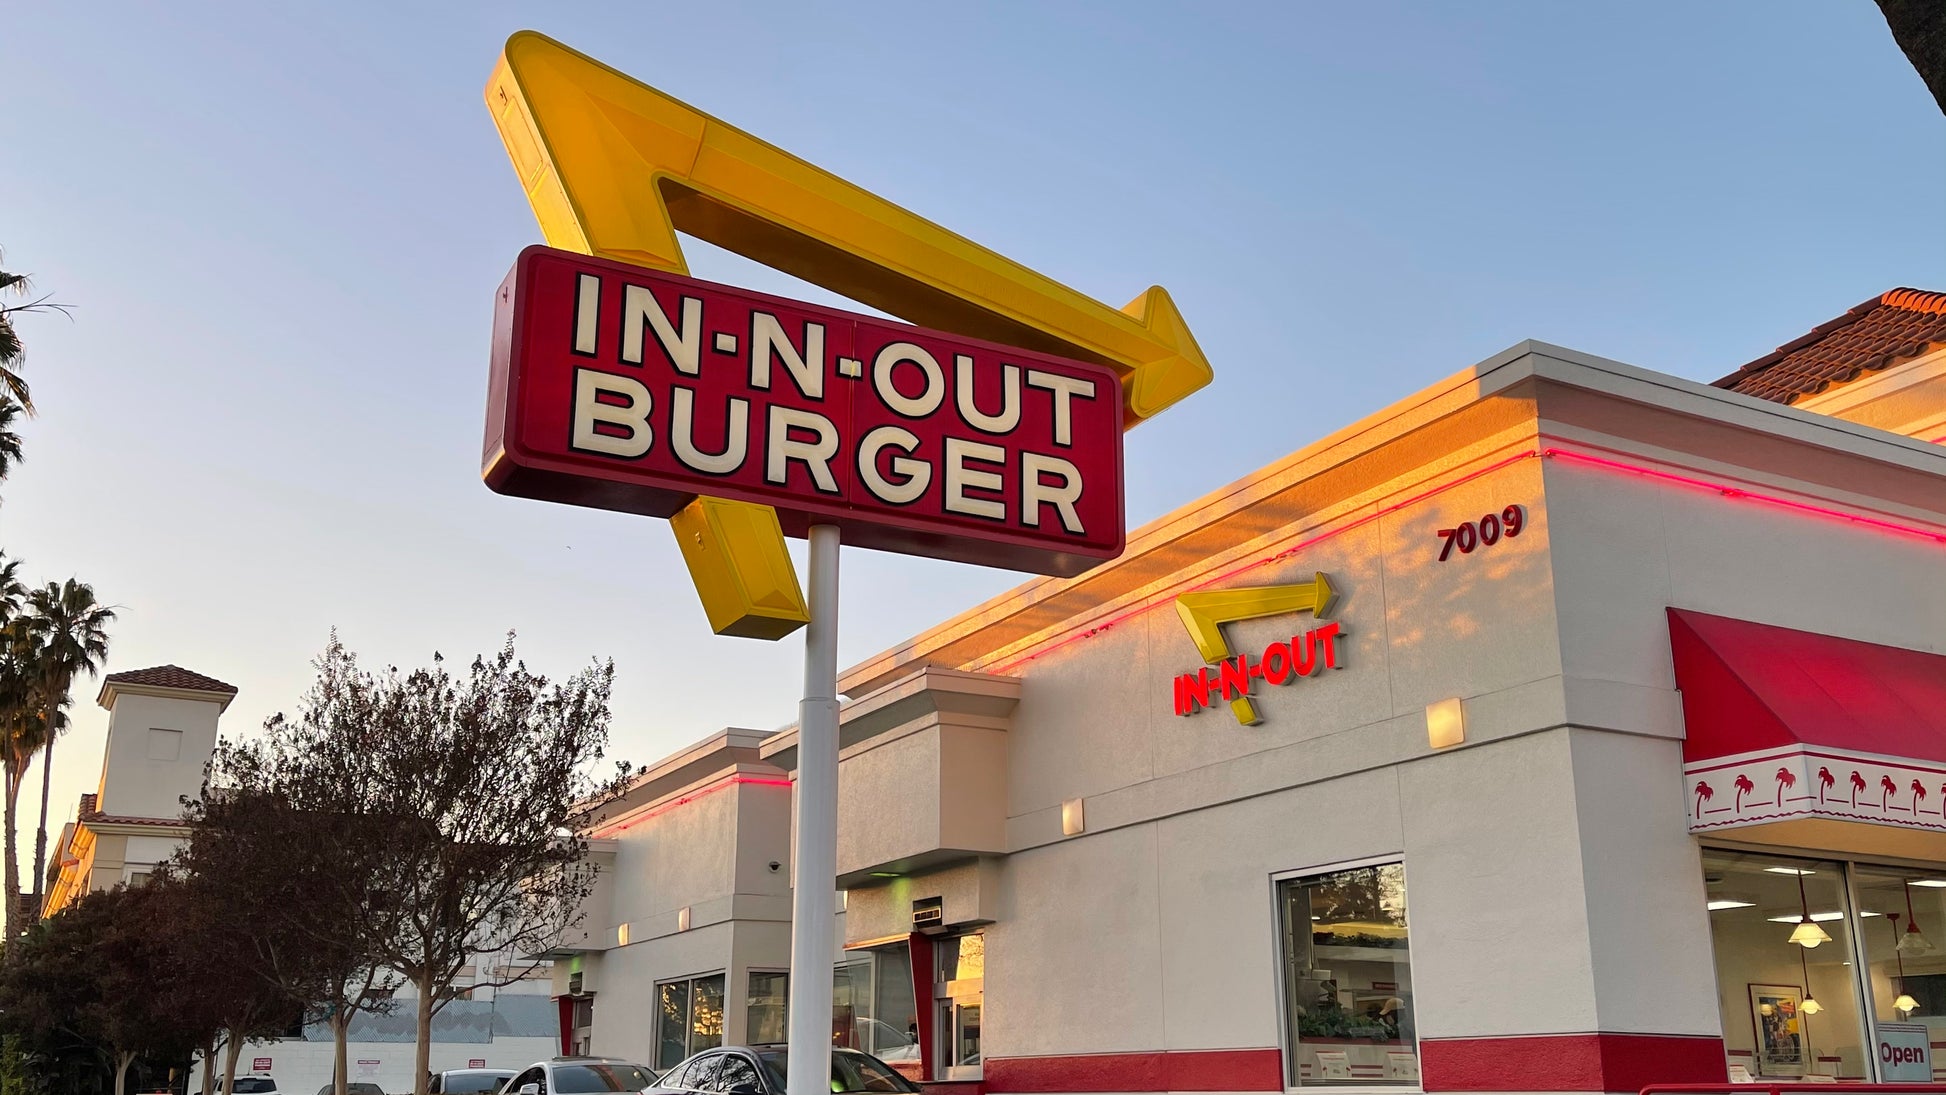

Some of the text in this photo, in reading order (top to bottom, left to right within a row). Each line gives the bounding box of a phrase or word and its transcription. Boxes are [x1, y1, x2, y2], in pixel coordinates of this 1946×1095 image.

[572, 273, 1096, 447] IN-N-OUT
[570, 367, 1086, 535] BURGER
[1437, 504, 1523, 562] 7009
[1174, 622, 1341, 717] IN-N-OUT
[1881, 1042, 1924, 1067] Open
